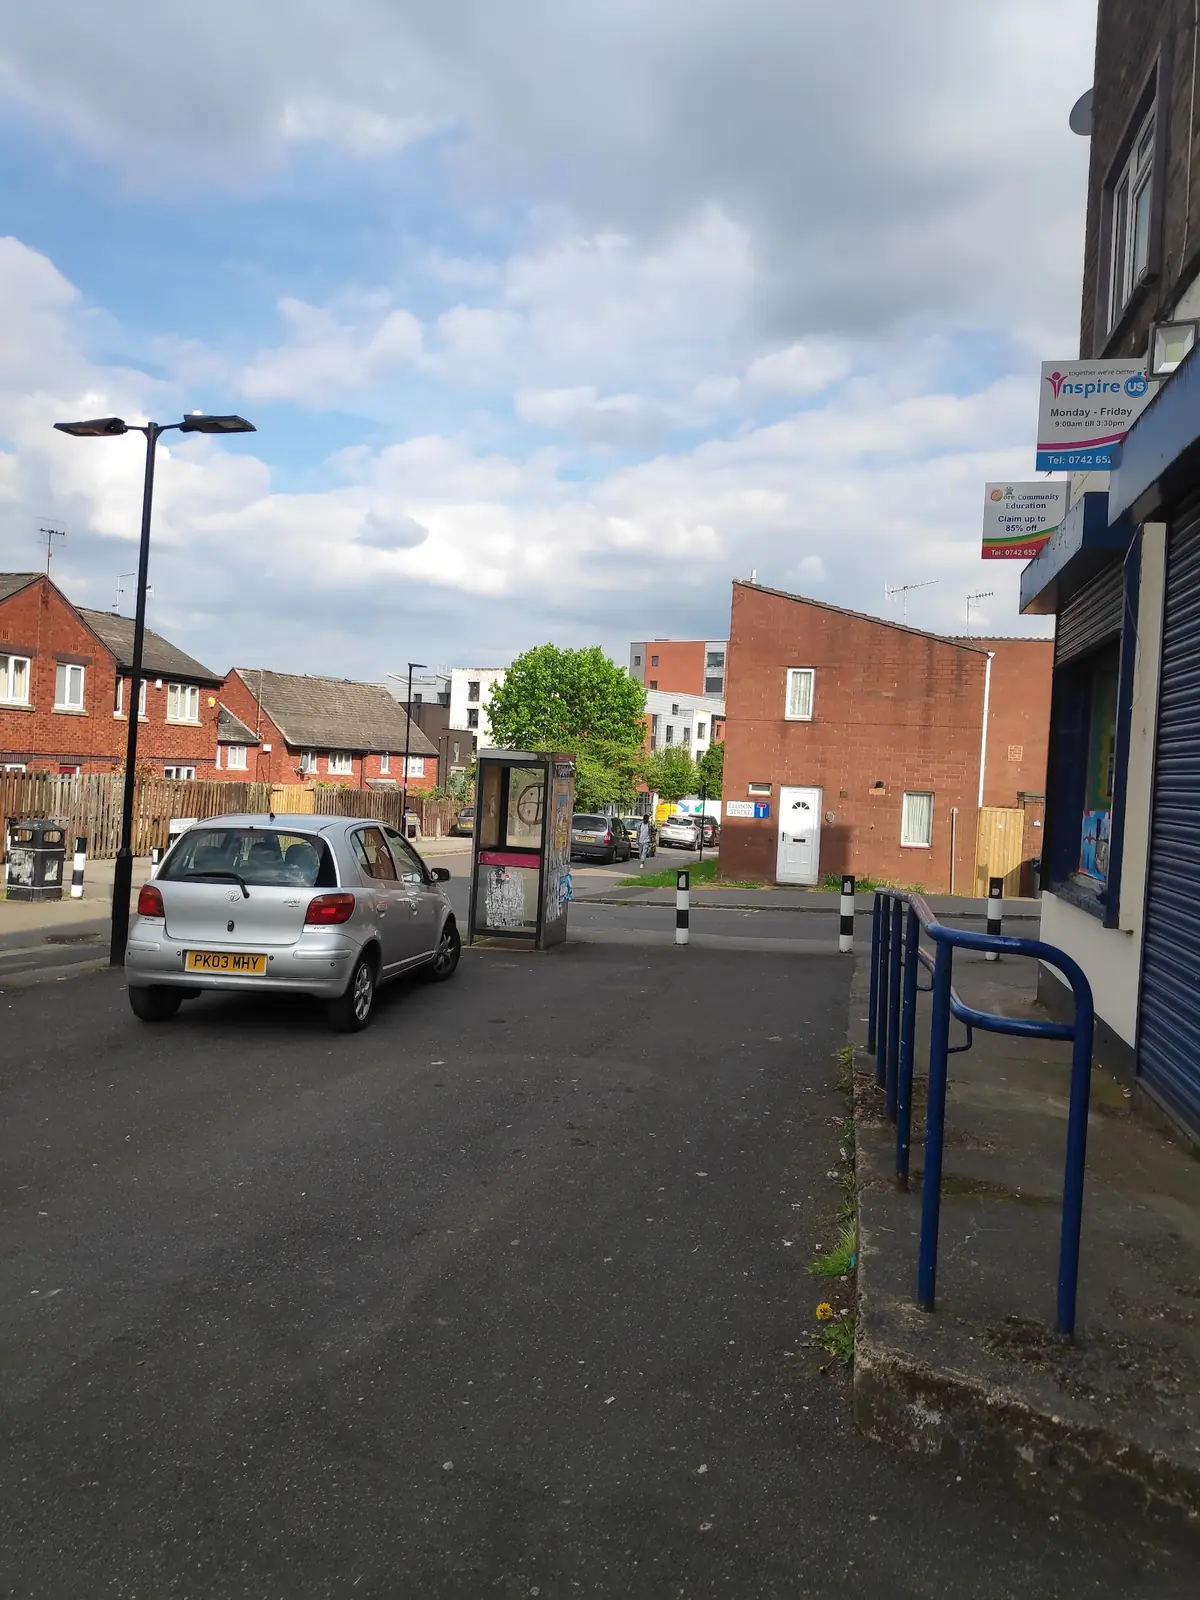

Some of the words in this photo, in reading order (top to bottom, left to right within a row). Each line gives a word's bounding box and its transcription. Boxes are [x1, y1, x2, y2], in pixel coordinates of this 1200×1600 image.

[1050, 408, 1091, 418] Monday
[1100, 408, 1133, 418] Friday
[1096, 420, 1125, 428] 3:30pm
[1048, 455, 1065, 464] Tel:
[1068, 455, 1093, 464] 0742
[1017, 493, 1060, 501] Community
[194, 954, 229, 968] PK03
[232, 956, 260, 970] MHY
